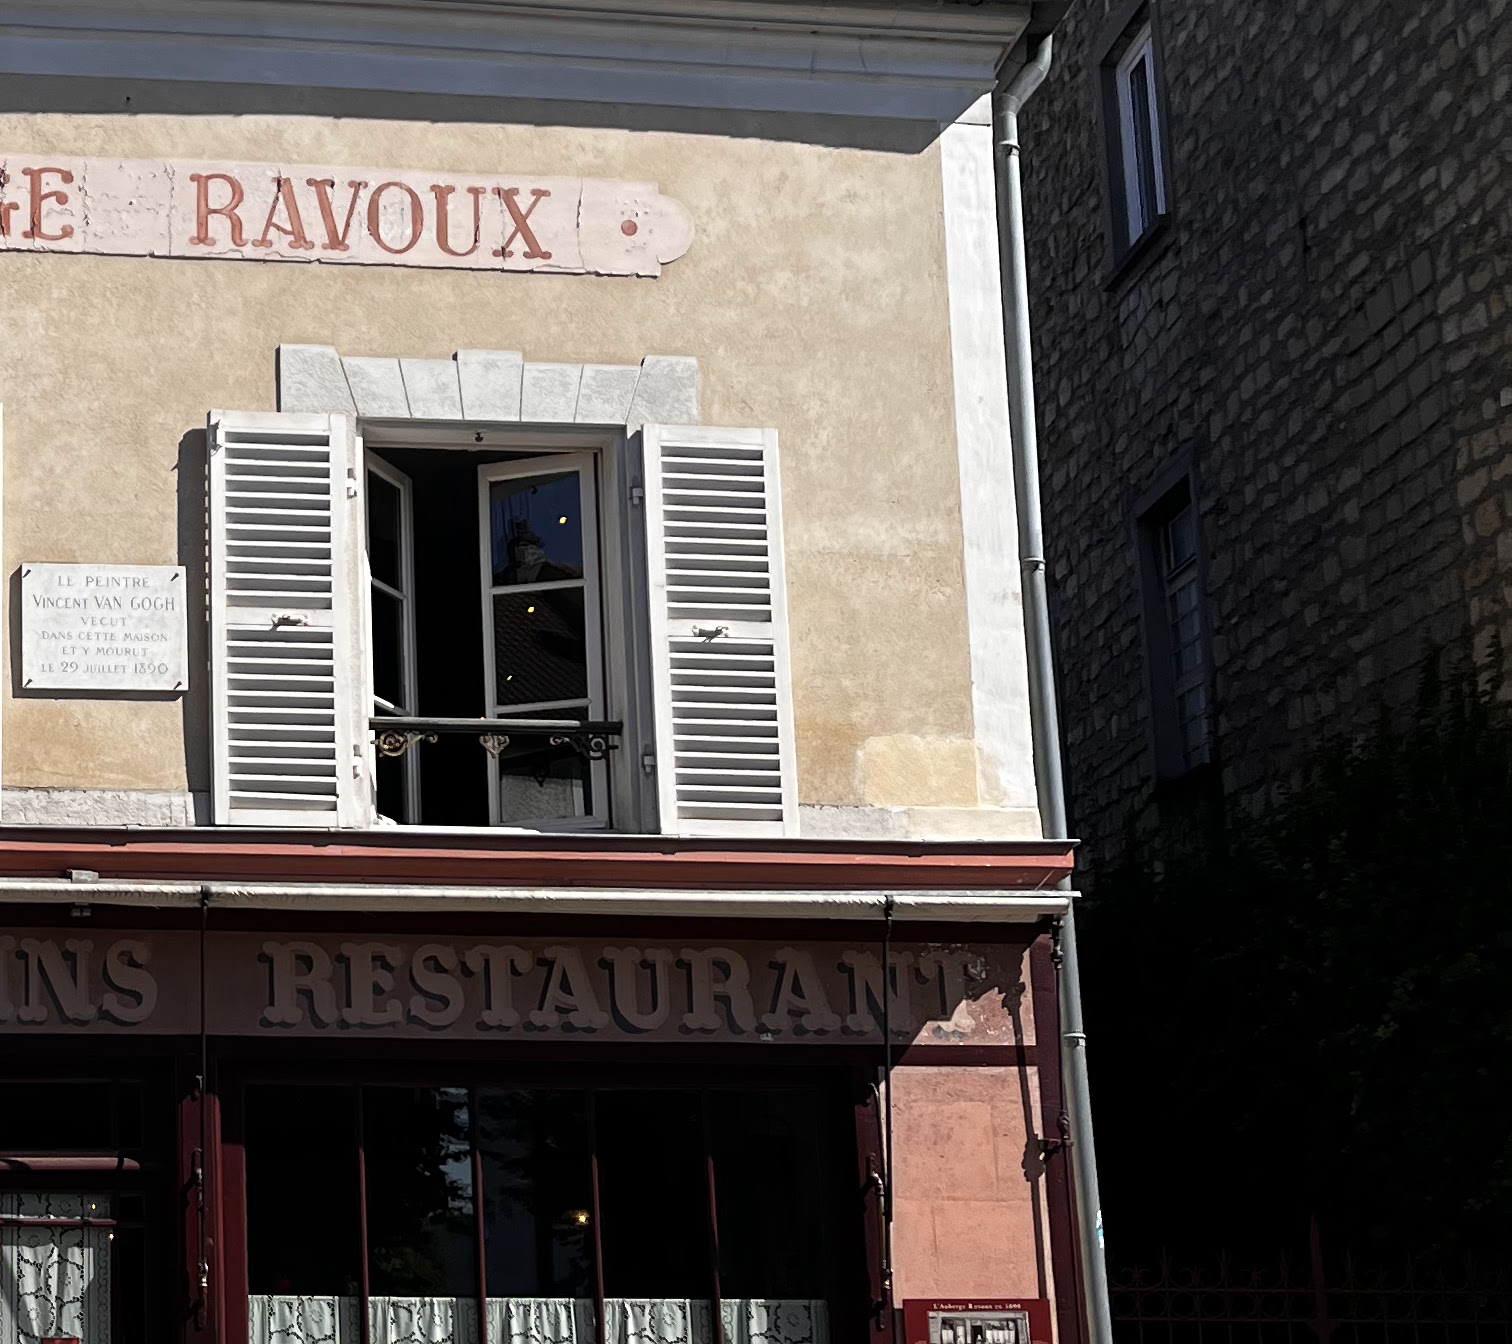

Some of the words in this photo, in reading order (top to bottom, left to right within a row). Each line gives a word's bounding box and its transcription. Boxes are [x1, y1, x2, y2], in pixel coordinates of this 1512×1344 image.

[189, 171, 552, 261] RAVOUX
[57, 575, 74, 587] LE
[85, 575, 151, 588] PEINTRE
[32, 594, 88, 610] VINCENT
[94, 595, 123, 611] VAN
[130, 596, 175, 612] GOGH
[42, 630, 73, 641] DANS
[77, 631, 116, 642] CETTE
[123, 632, 168, 642] MAISON
[62, 645, 77, 655] ET
[82, 646, 90, 656] Y
[96, 646, 149, 657] MOURUT
[41, 663, 54, 673] LE
[60, 661, 79, 673] 29
[83, 664, 127, 674] JUILLET
[134, 662, 169, 675] 1890
[258, 939, 982, 1039] RESTAURANT
